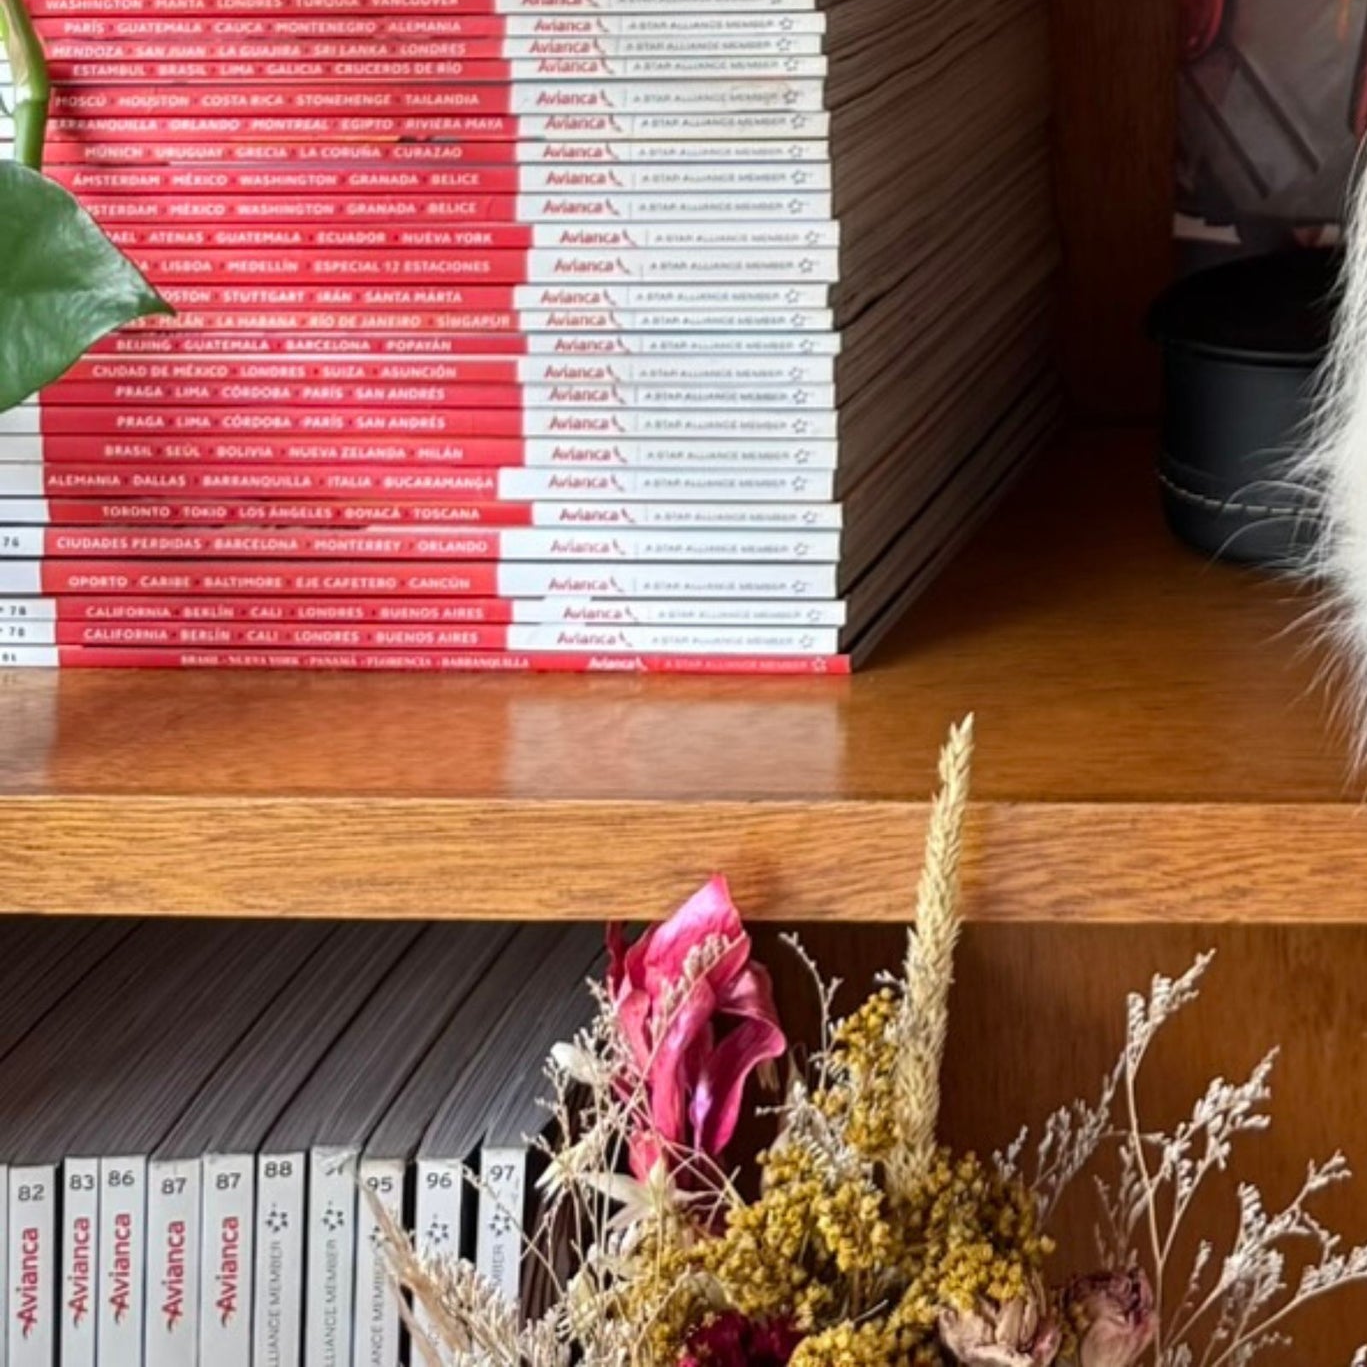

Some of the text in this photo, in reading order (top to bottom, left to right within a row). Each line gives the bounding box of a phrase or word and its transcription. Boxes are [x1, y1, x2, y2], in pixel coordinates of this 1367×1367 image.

[550, 539, 610, 554] Avianca
[107, 1170, 136, 1188] 86
[264, 1160, 293, 1179] 88
[490, 1164, 516, 1182] 97
[69, 1174, 96, 1193] 83
[161, 1177, 188, 1196] 87
[215, 1172, 243, 1191] 87
[366, 1176, 393, 1193] 95
[426, 1172, 453, 1189] 96
[17, 1184, 46, 1203] 82
[67, 1216, 92, 1317] Avianca
[107, 1212, 132, 1313] Avianca
[215, 1215, 240, 1328] Avianca
[325, 1238, 338, 1301] MEMBER
[16, 1227, 40, 1327] Avianca
[161, 1220, 187, 1331] Avianca
[269, 1240, 282, 1306] MEMBER
